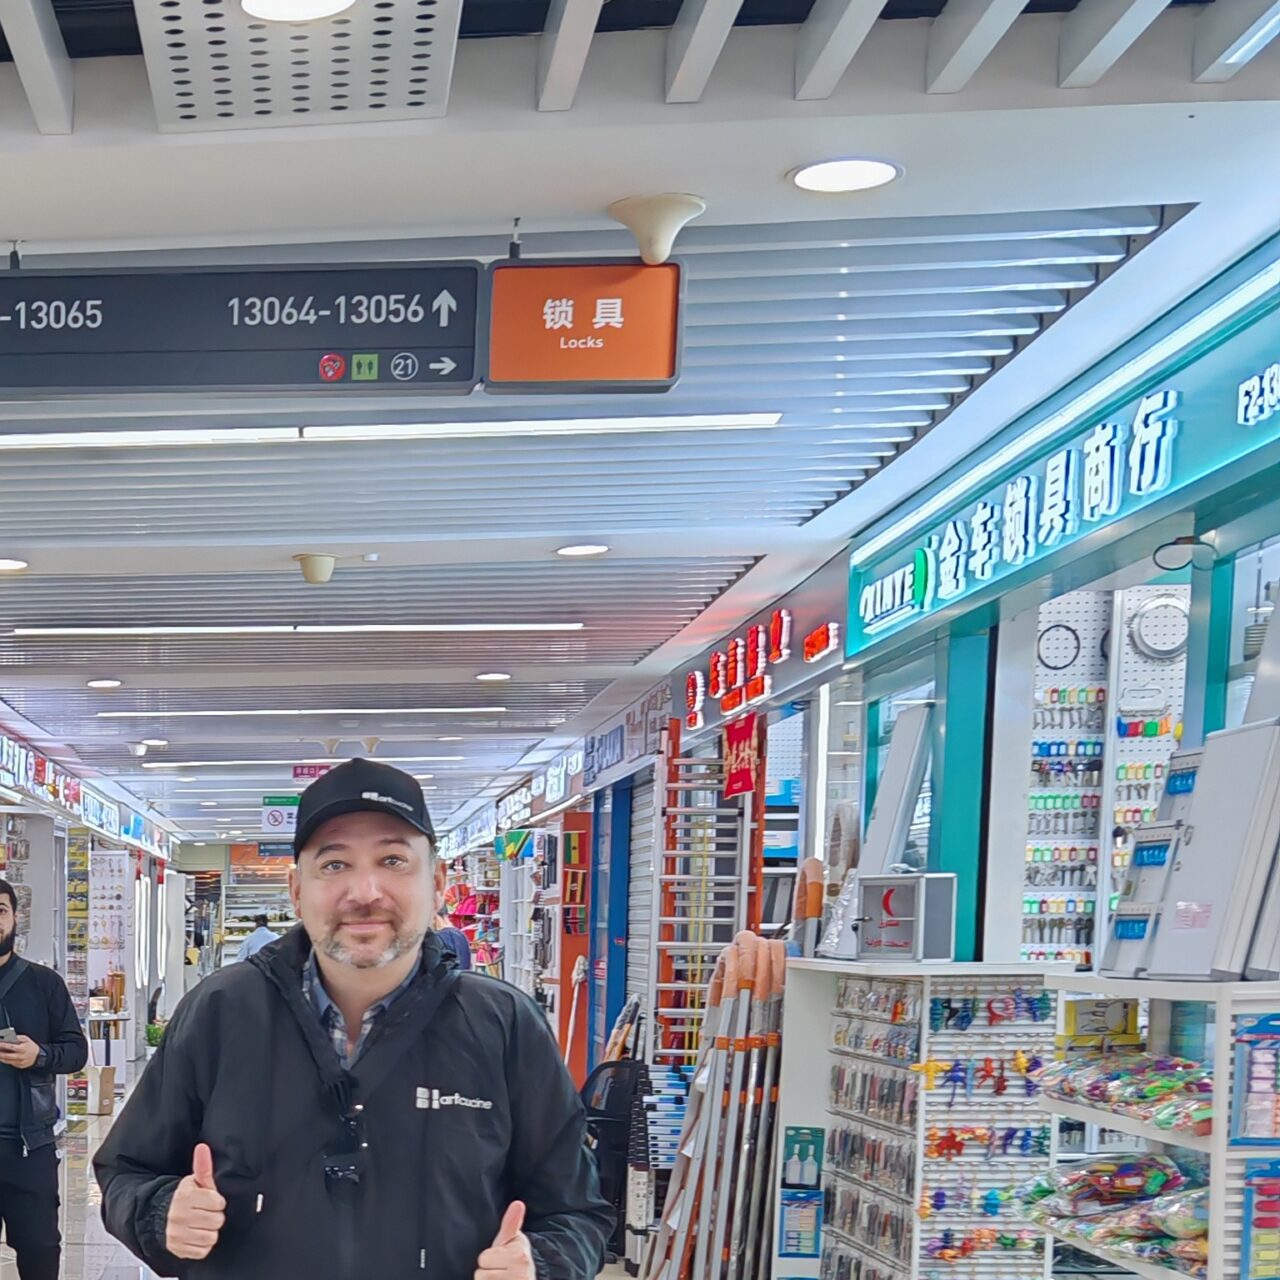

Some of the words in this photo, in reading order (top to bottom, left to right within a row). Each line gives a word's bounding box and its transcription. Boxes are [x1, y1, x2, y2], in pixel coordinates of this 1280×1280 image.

[228, 294, 425, 326] 13064-13056
[543, 298, 624, 329] 锁具
[560, 336, 604, 349] Locks
[393, 357, 416, 377] 21
[1237, 364, 1280, 425] F2-13
